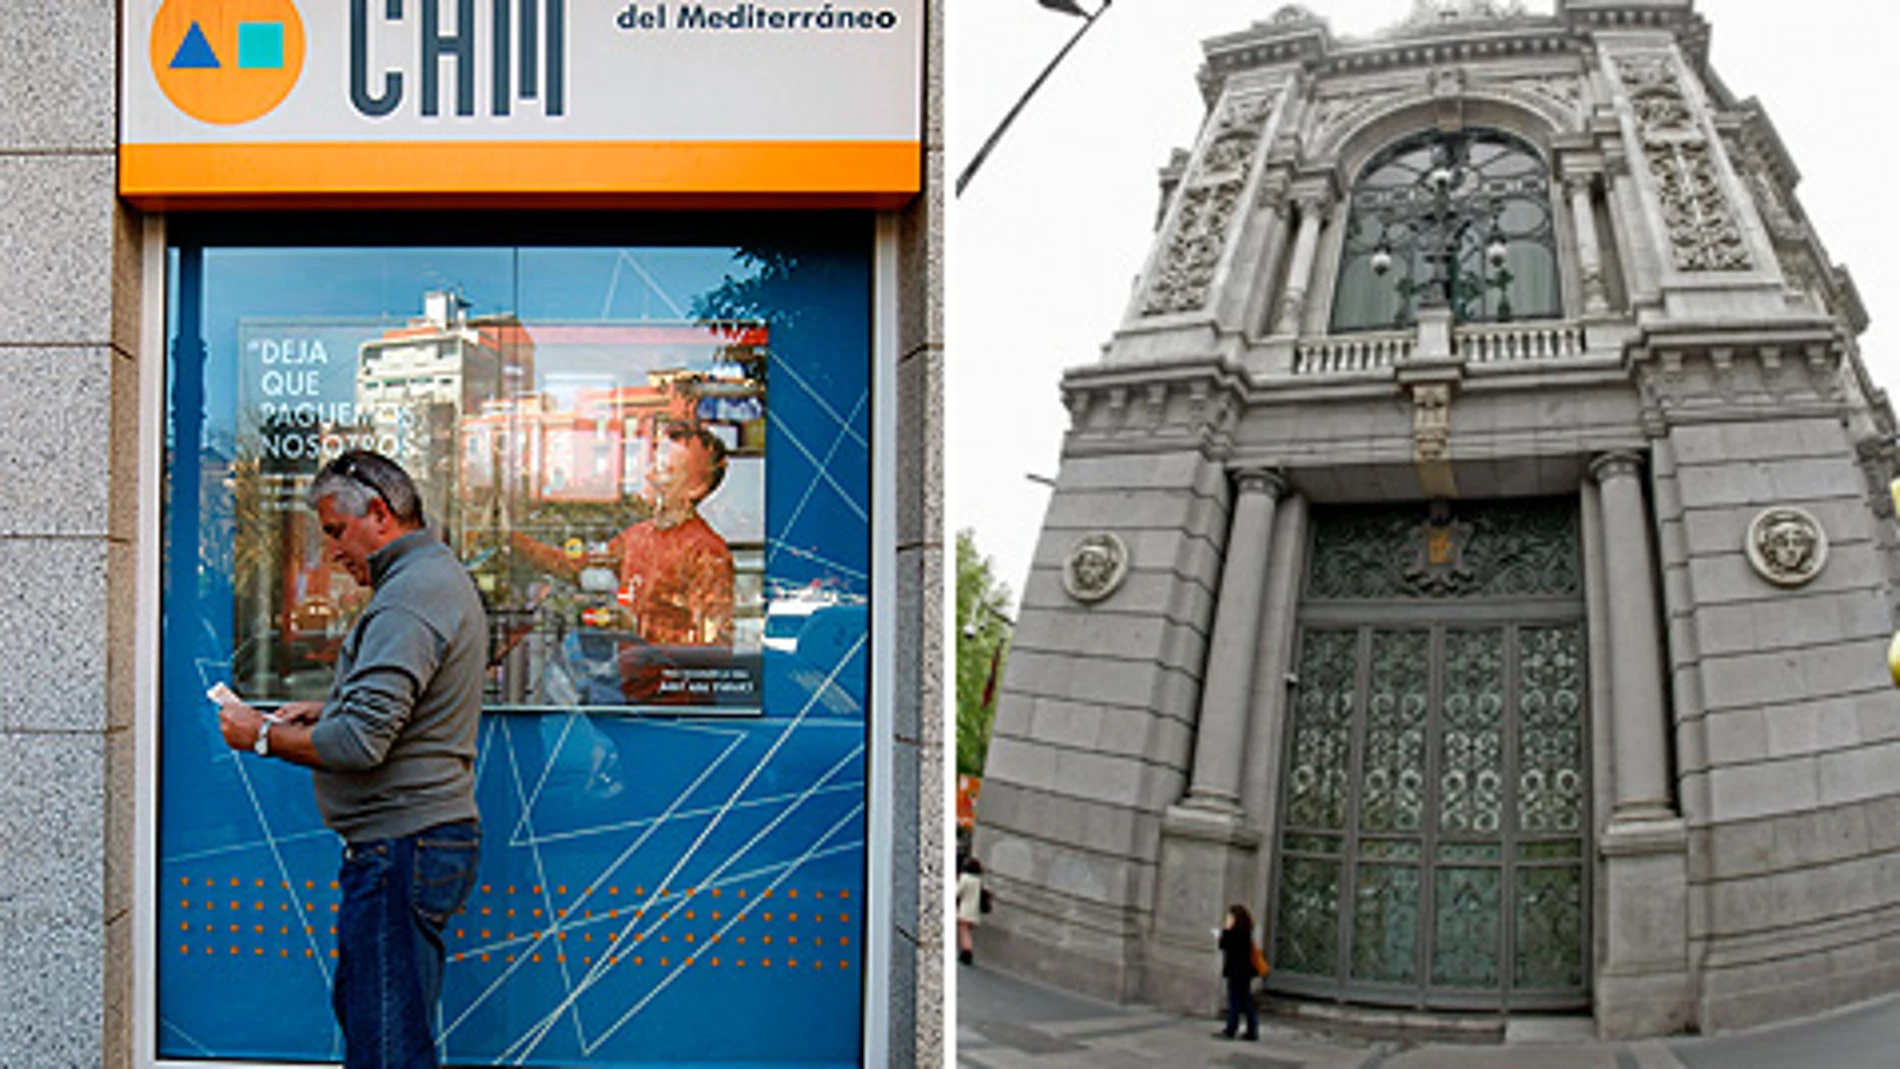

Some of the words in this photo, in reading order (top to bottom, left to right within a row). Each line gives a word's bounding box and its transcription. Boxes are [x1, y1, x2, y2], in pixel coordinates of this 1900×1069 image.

[616, 4, 666, 28] del
[676, 4, 897, 29] Mediterráneo
[261, 370, 320, 396] QUE
